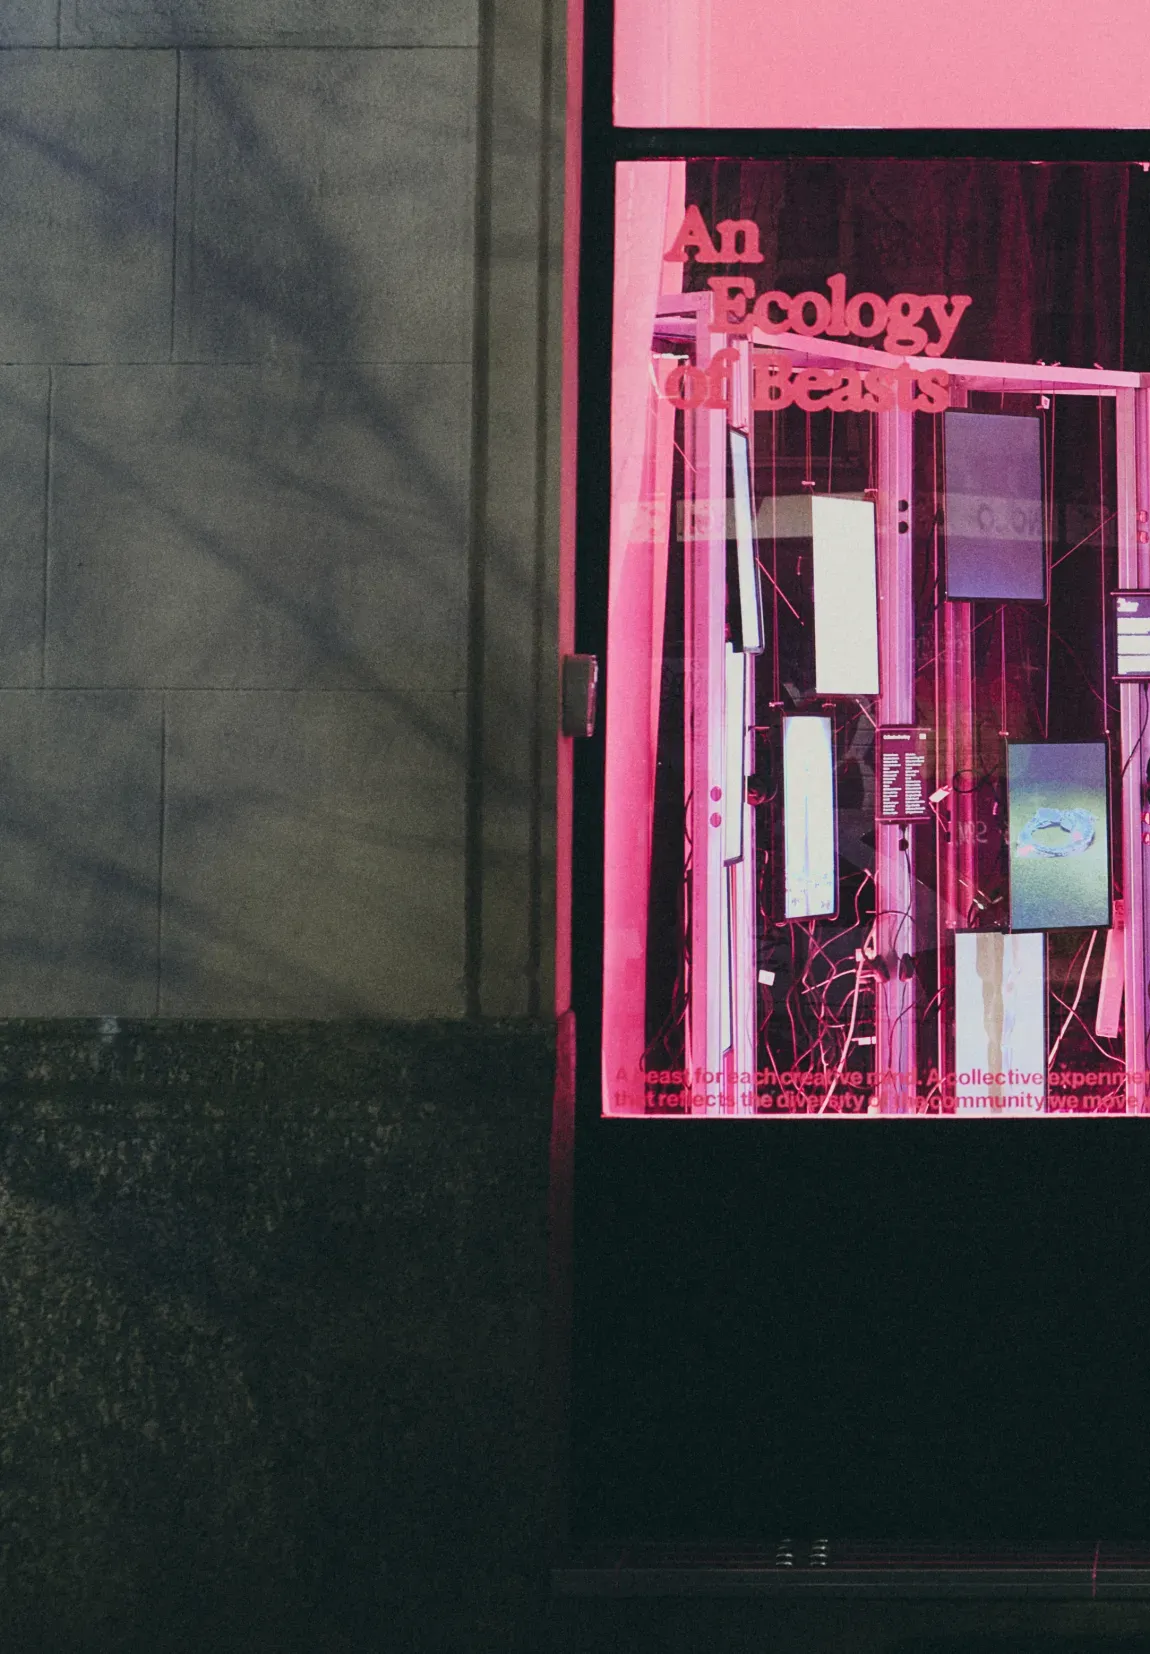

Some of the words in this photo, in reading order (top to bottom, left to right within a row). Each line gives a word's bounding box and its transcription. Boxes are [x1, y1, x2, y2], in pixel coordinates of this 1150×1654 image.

[663, 204, 764, 263] An
[707, 272, 973, 357] Ecology
[664, 347, 740, 410] of
[750, 352, 952, 414] Beasts
[633, 1067, 691, 1085] east
[694, 1067, 724, 1084] for
[726, 1067, 777, 1085] each
[926, 1067, 943, 1086] A
[946, 1068, 1044, 1086] collective
[741, 1090, 773, 1108] the
[929, 1091, 1046, 1113] community
[1047, 1094, 1078, 1109] we
